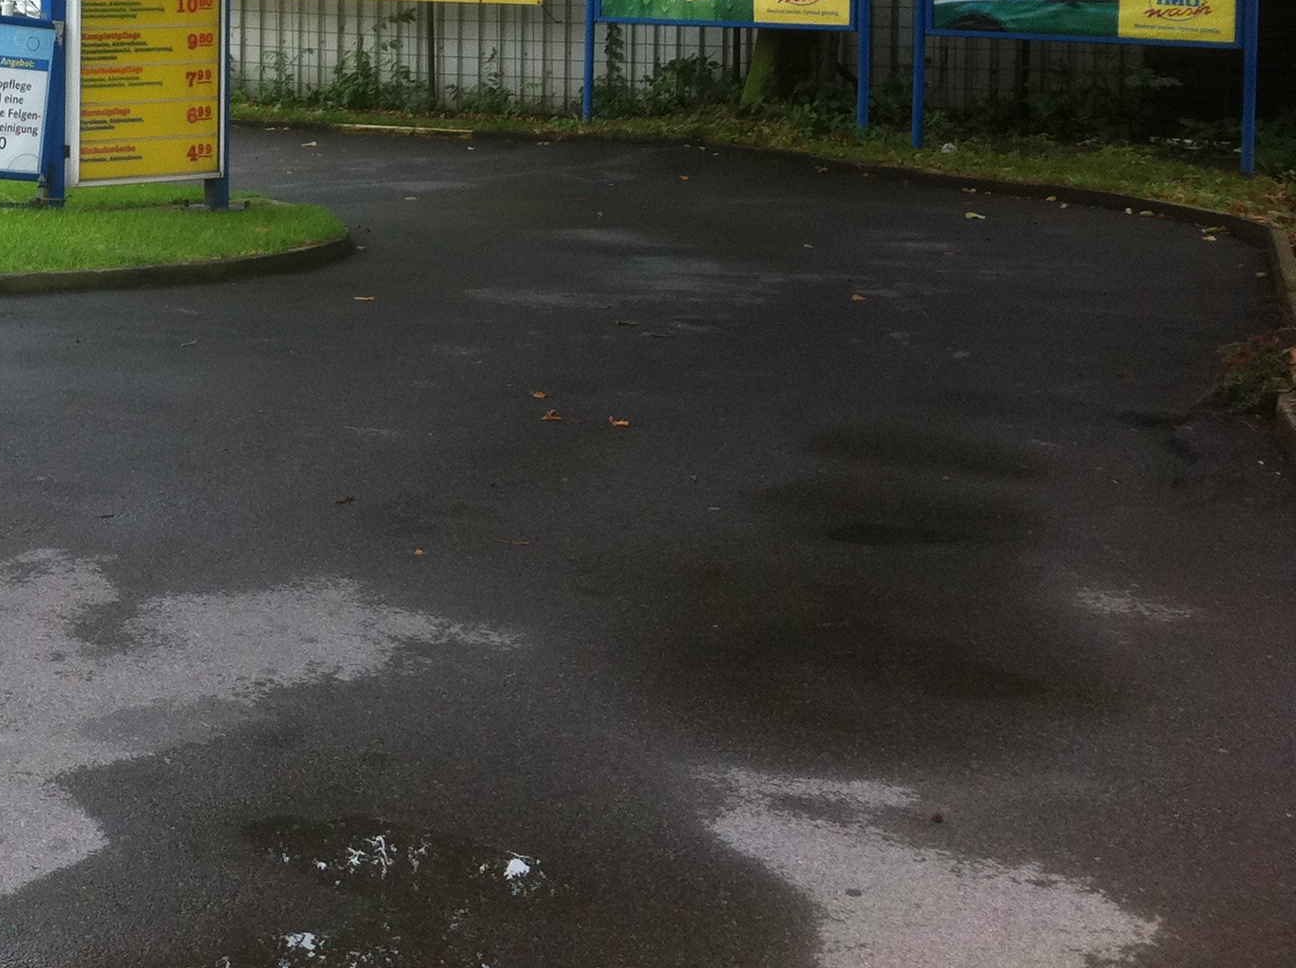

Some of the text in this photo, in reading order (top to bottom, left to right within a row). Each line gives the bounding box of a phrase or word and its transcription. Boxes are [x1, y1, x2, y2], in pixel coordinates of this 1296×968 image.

[1144, 1, 1213, 18] wash
[4, 95, 24, 105] eine
[8, 109, 41, 122] Felgen-
